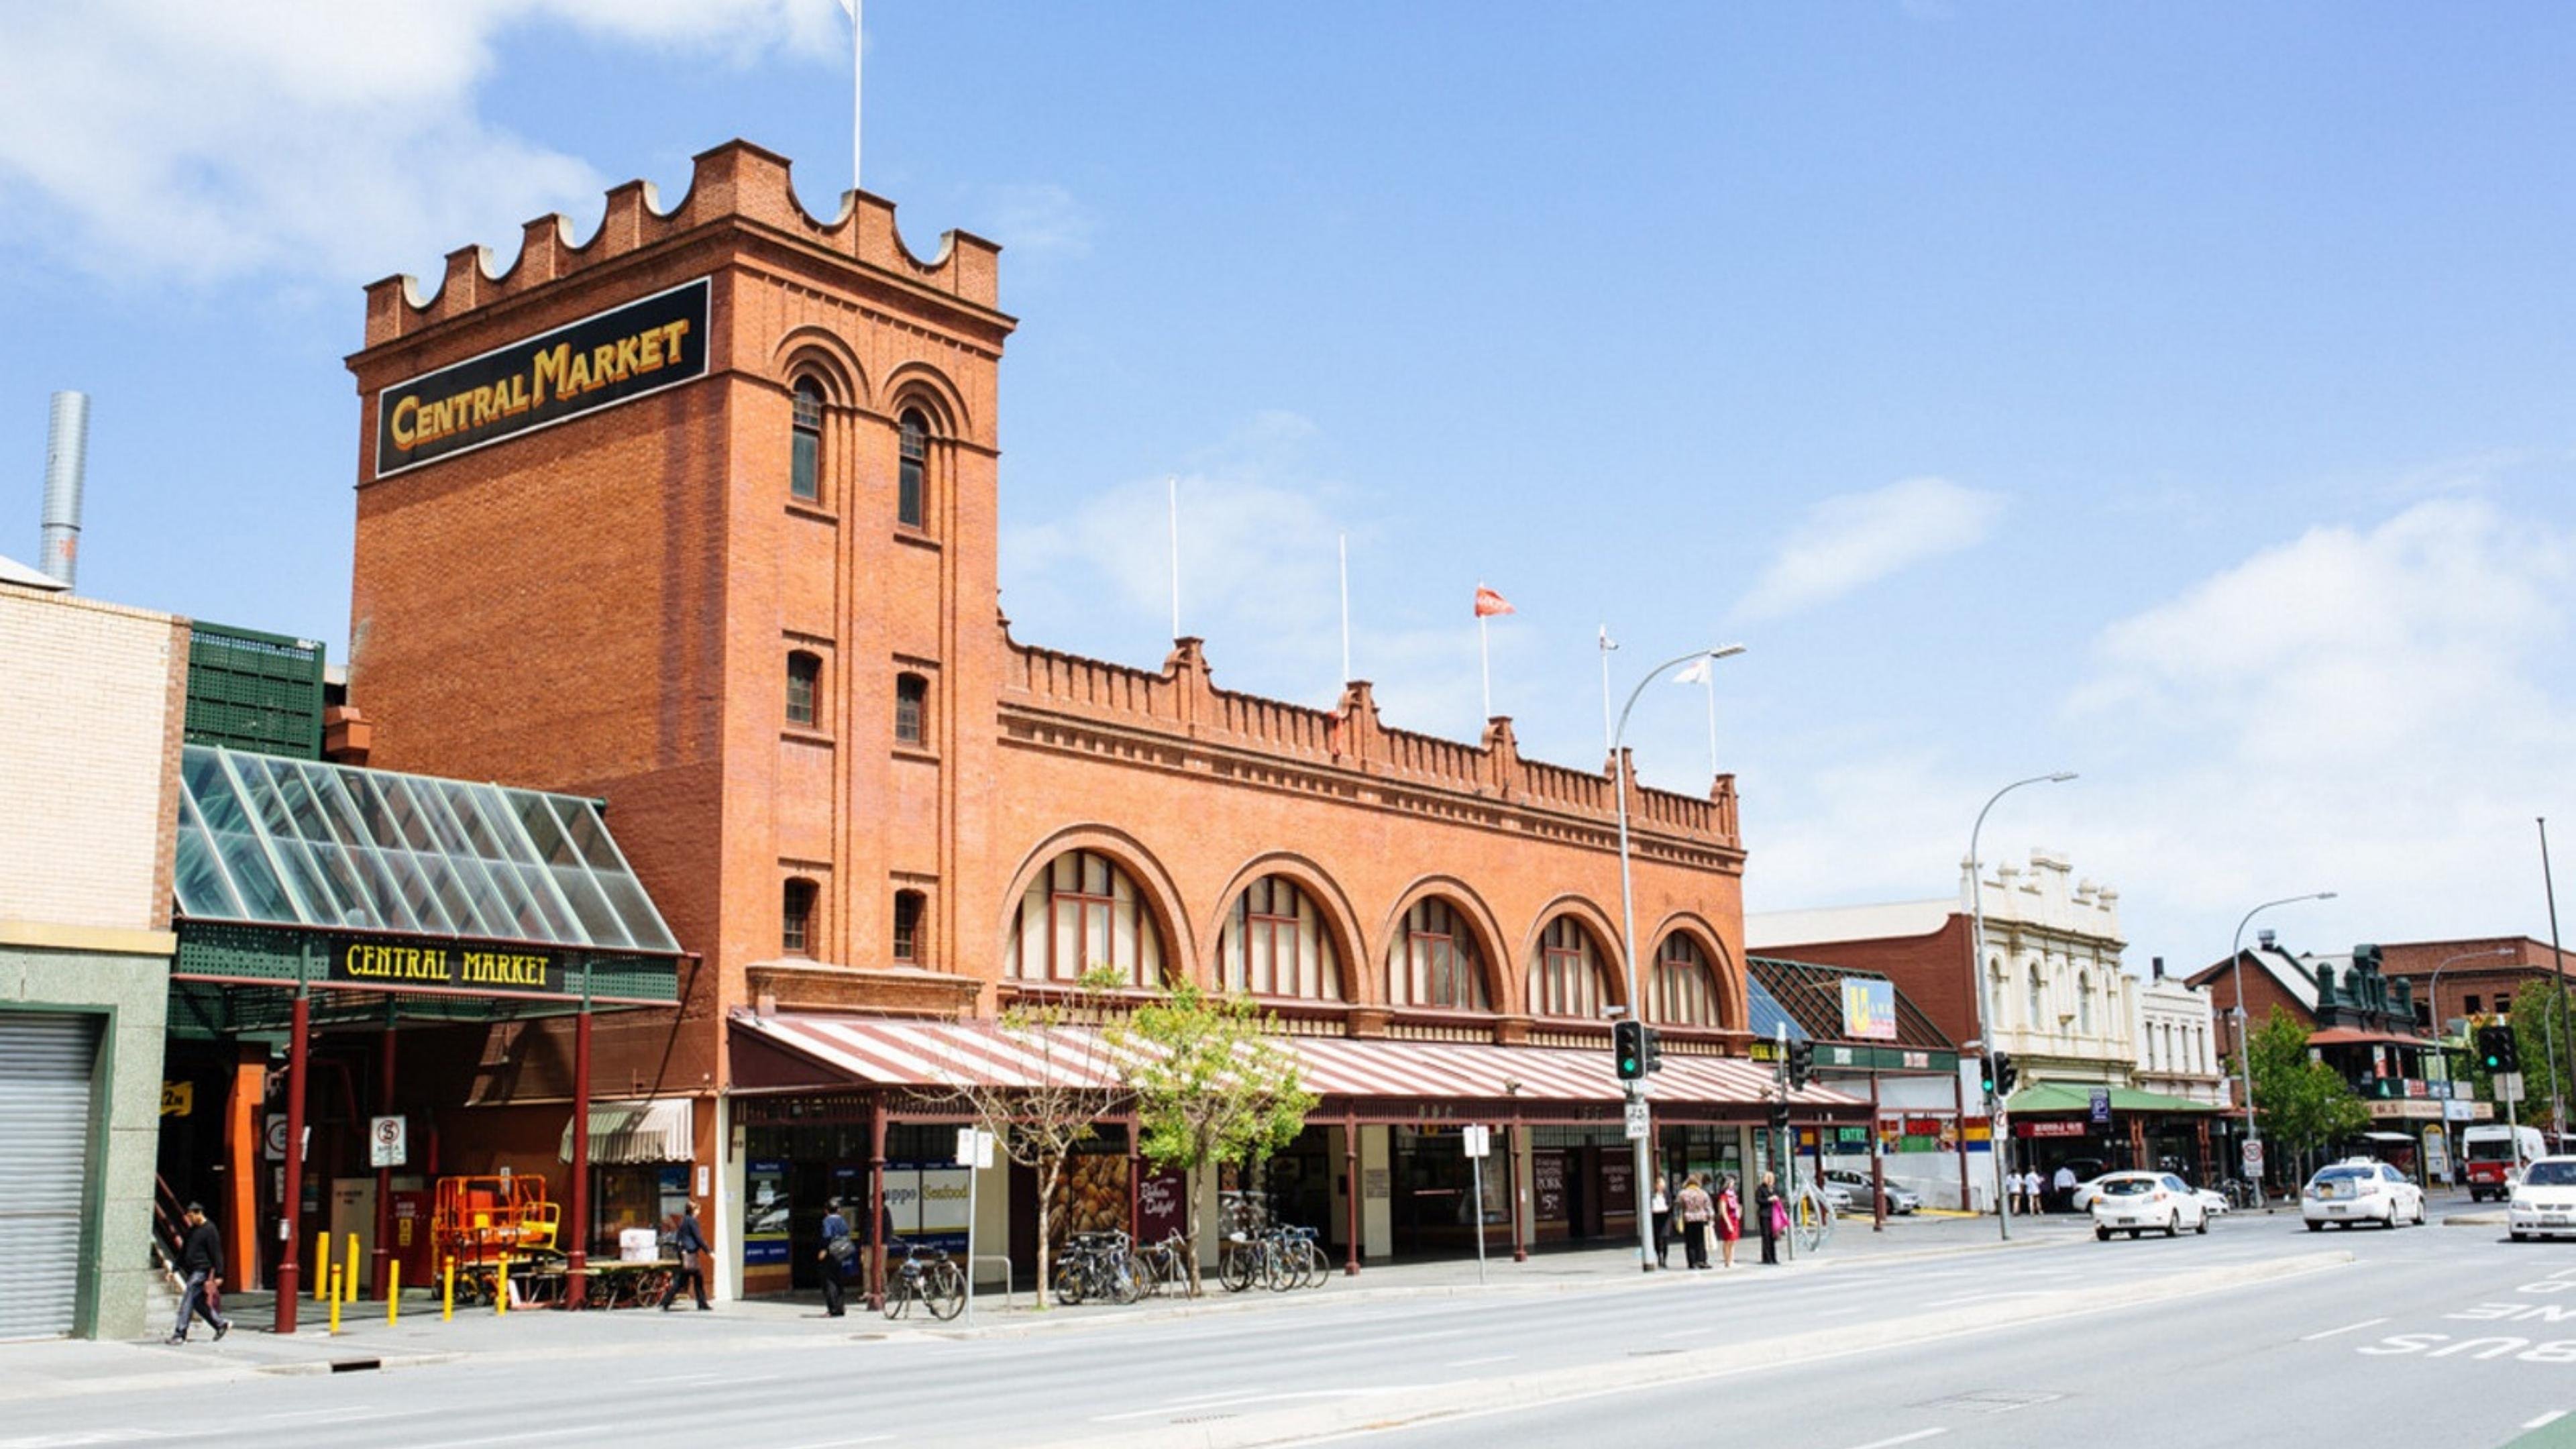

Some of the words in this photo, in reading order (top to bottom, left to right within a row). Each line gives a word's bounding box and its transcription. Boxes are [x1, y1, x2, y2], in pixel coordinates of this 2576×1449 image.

[391, 373, 531, 451] CENTRAL
[532, 318, 690, 408] MARKET
[346, 944, 450, 979] CENTRAL
[462, 951, 549, 985] MARKET
[2356, 1333, 2576, 1362] BUS
